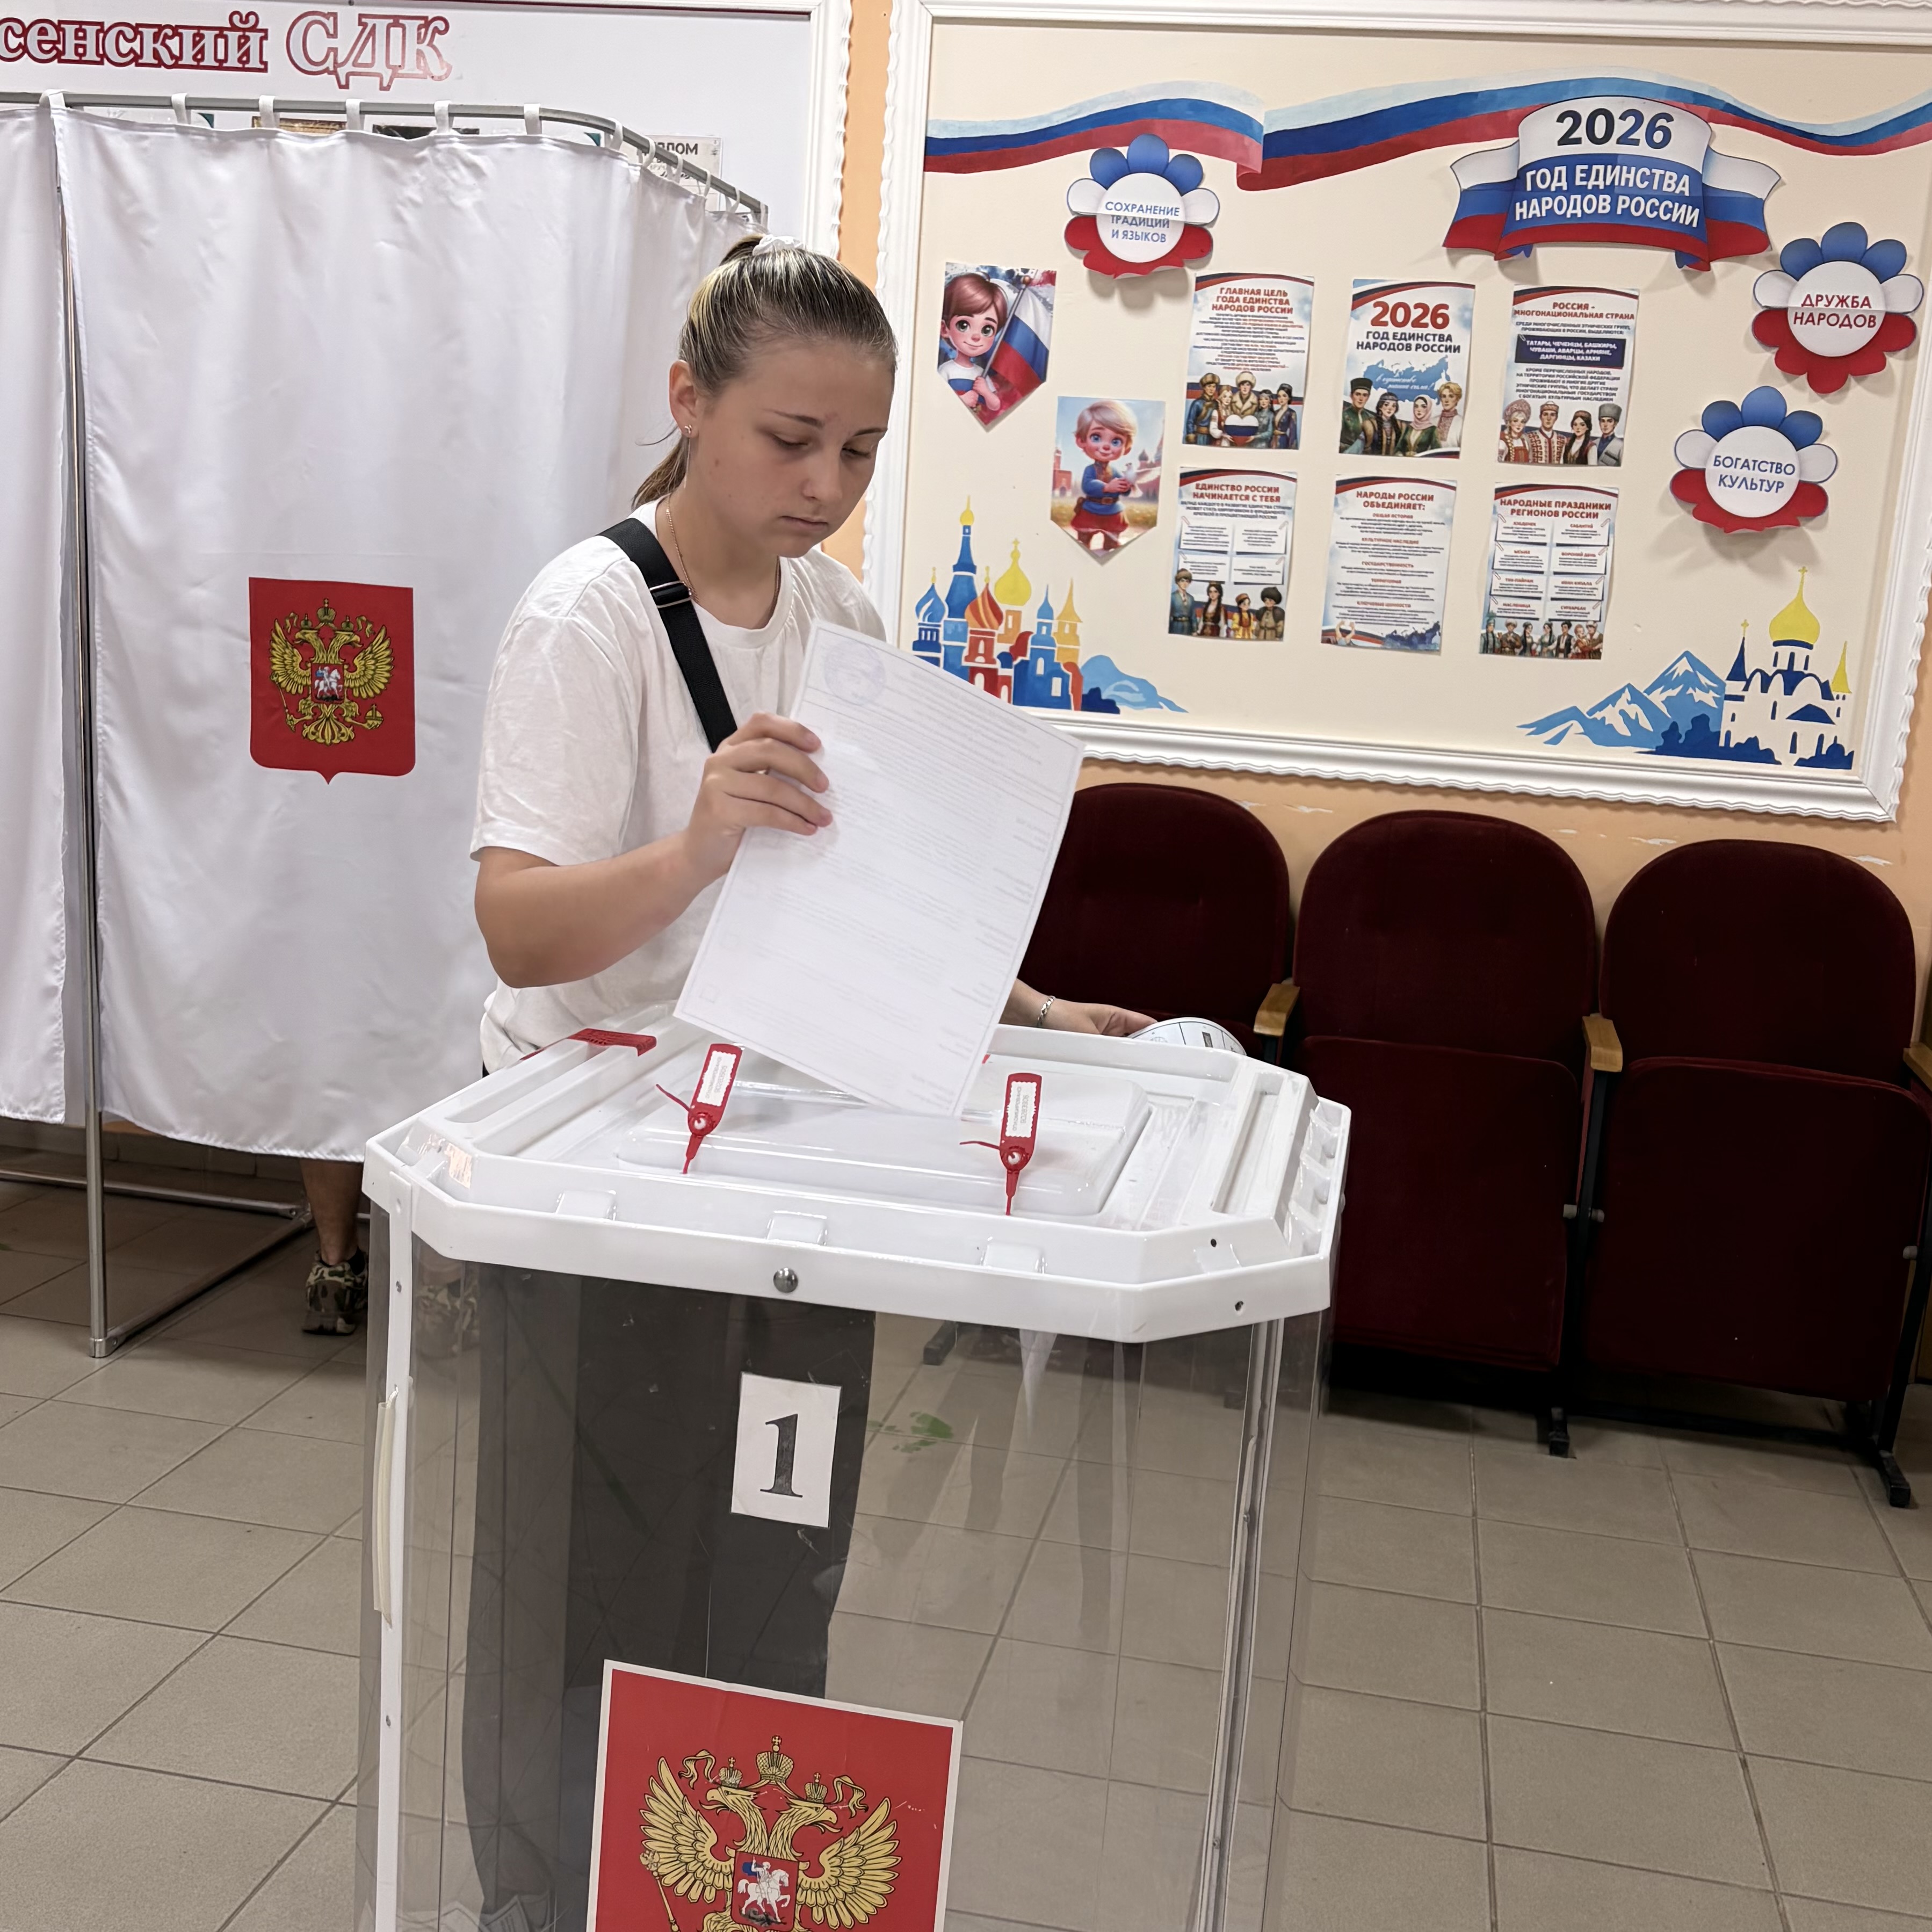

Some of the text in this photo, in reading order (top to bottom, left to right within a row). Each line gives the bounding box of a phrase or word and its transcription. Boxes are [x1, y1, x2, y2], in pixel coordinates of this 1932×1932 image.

[286, 11, 452, 91] СДК
[1556, 108, 1674, 149] 2026
[1526, 164, 1690, 197] ГОД ЕДИНСТВА
[1105, 201, 1180, 215] СОХРАНЕНИЕ
[1515, 194, 1700, 228] НАРОДОВ РОССИИ
[1111, 229, 1166, 242] И ЯЗЫКОВ
[1220, 287, 1287, 298] ГЛАВНАЯ ЦЕЛЬ
[1216, 295, 1290, 306] ГОДА ЕДИНСТВА
[1801, 294, 1871, 309] ДРУЖБА
[1211, 303, 1293, 314] НАРОДОВ РОССИИ
[1514, 310, 1603, 319] МНОГОНАЦИОНАЛЬНАЯ
[1370, 301, 1449, 329] 2026
[1793, 312, 1876, 329] НАРОДОВ
[1366, 331, 1452, 343] ГОД ЕДИНСТВА
[1356, 341, 1460, 353] НАРОДОВ РОССИИ
[1713, 455, 1795, 475] БОГАТСТВО
[1195, 483, 1279, 493] ЕДИНСТВО РОССИИ
[1718, 475, 1784, 493] КУЛЬТУР
[1192, 492, 1249, 501] НАЧИНАЕТСЯ
[1356, 491, 1434, 501] НАРОДЫ РОССИИ
[1363, 500, 1425, 511] ОБЪЕДИНЯЕТ:
[1500, 498, 1611, 510] НАРОДНЫЕ ПРАЗДНИКИ
[1510, 508, 1598, 519] РЕГИОНОВ РОССИИ
[759, 1413, 804, 1498] 1
